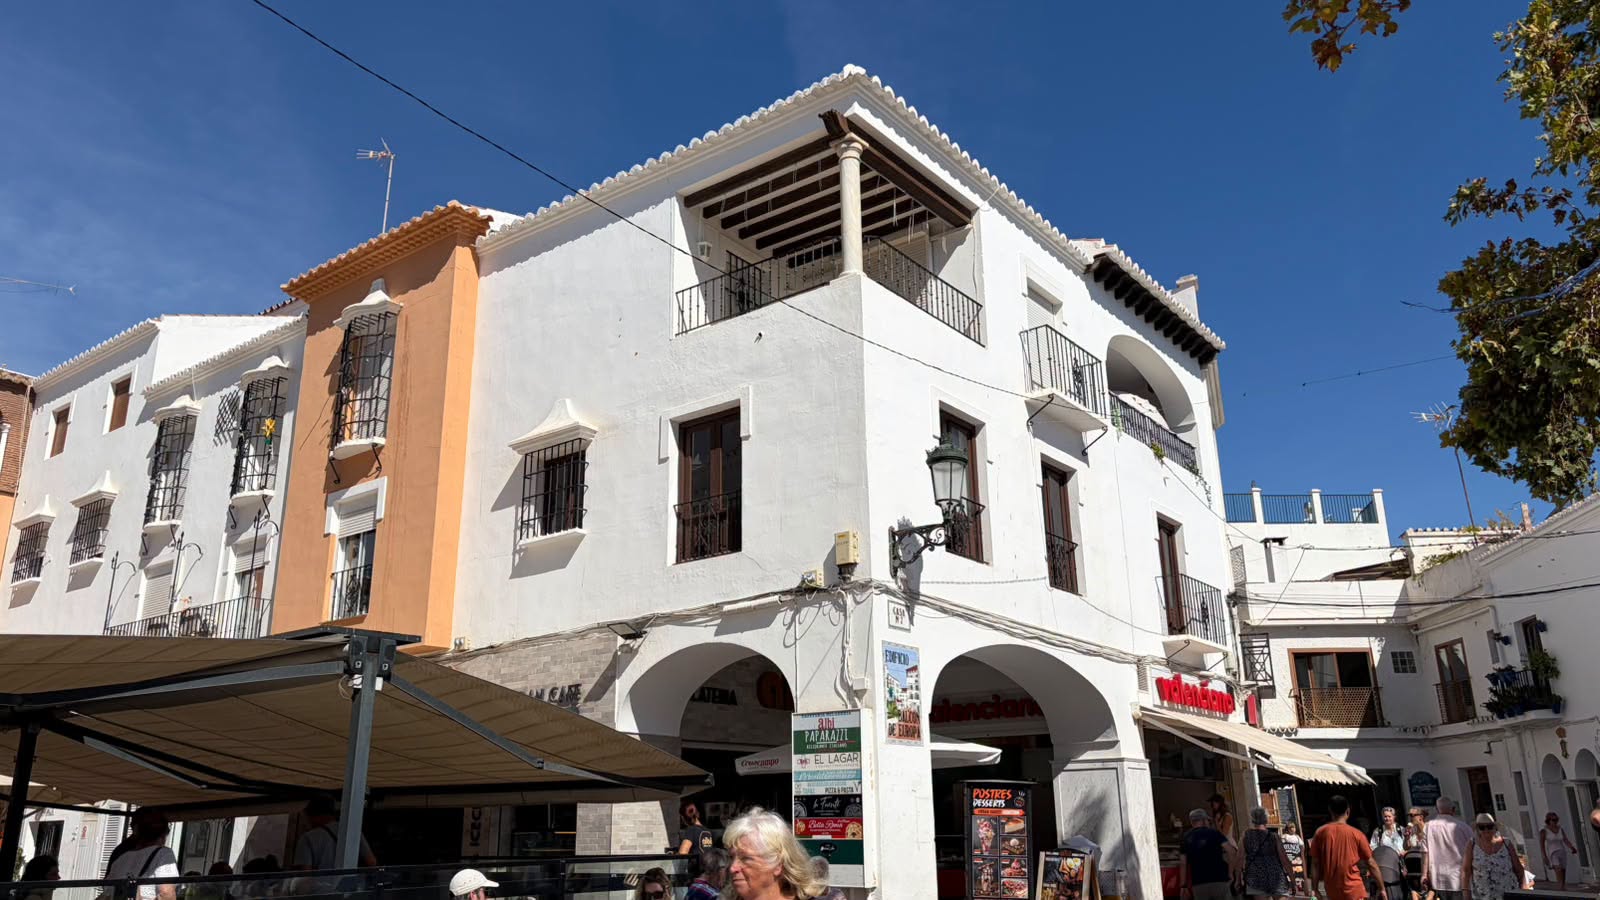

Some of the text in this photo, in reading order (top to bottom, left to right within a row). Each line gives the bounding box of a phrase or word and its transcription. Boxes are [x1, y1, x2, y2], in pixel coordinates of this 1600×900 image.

[892, 606, 905, 617] CASA
[885, 649, 909, 666] EDIFICIO
[1155, 673, 1236, 715] valenciano
[817, 718, 835, 731] albi
[888, 722, 921, 739] DE EUROPA
[804, 728, 849, 743] PAPARAZZI
[814, 754, 824, 765] EL
[828, 752, 859, 764] LAGAR
[973, 788, 1012, 800] POSTRES
[972, 799, 1006, 808] DESSERTS
